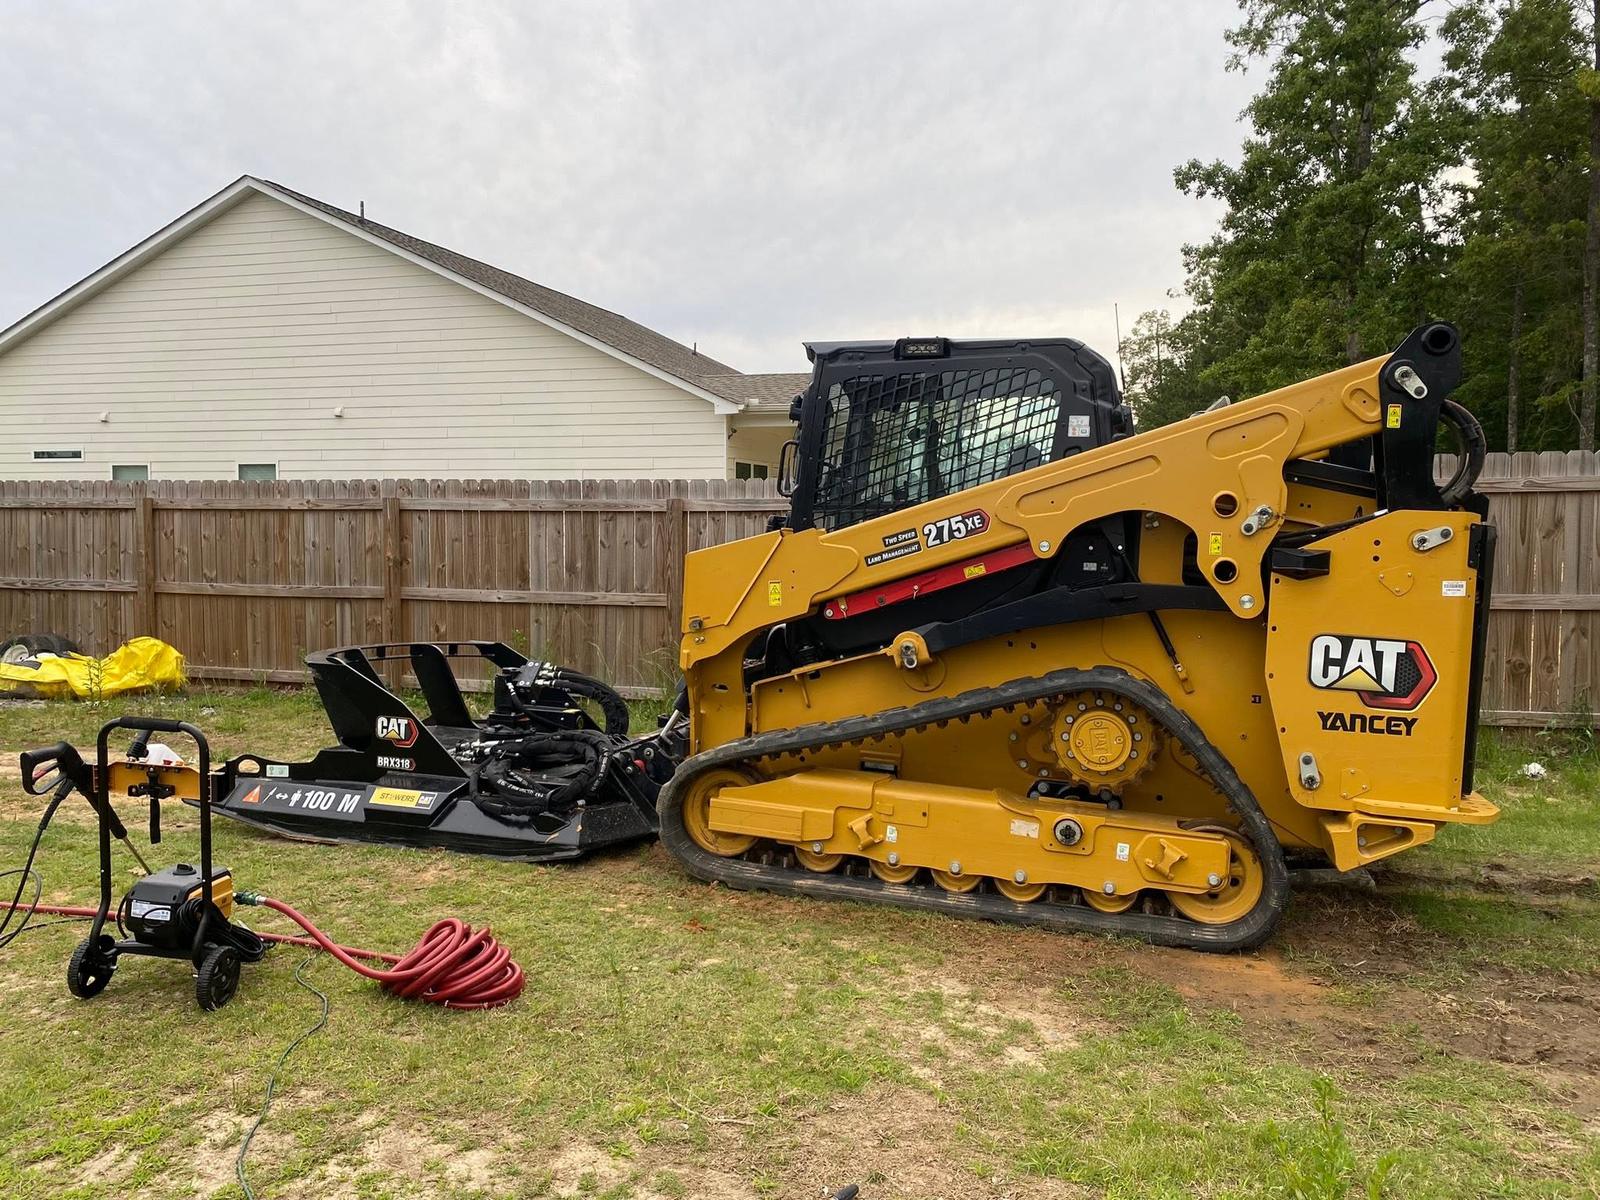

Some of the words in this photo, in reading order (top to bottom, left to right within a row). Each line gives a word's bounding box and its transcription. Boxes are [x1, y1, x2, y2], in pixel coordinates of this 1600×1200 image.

[1310, 635, 1407, 693] CAT
[377, 716, 408, 740] CAT
[1317, 711, 1419, 736] YANCEY
[377, 756, 410, 769] BRX318
[302, 790, 335, 811] 100
[337, 793, 361, 813] M
